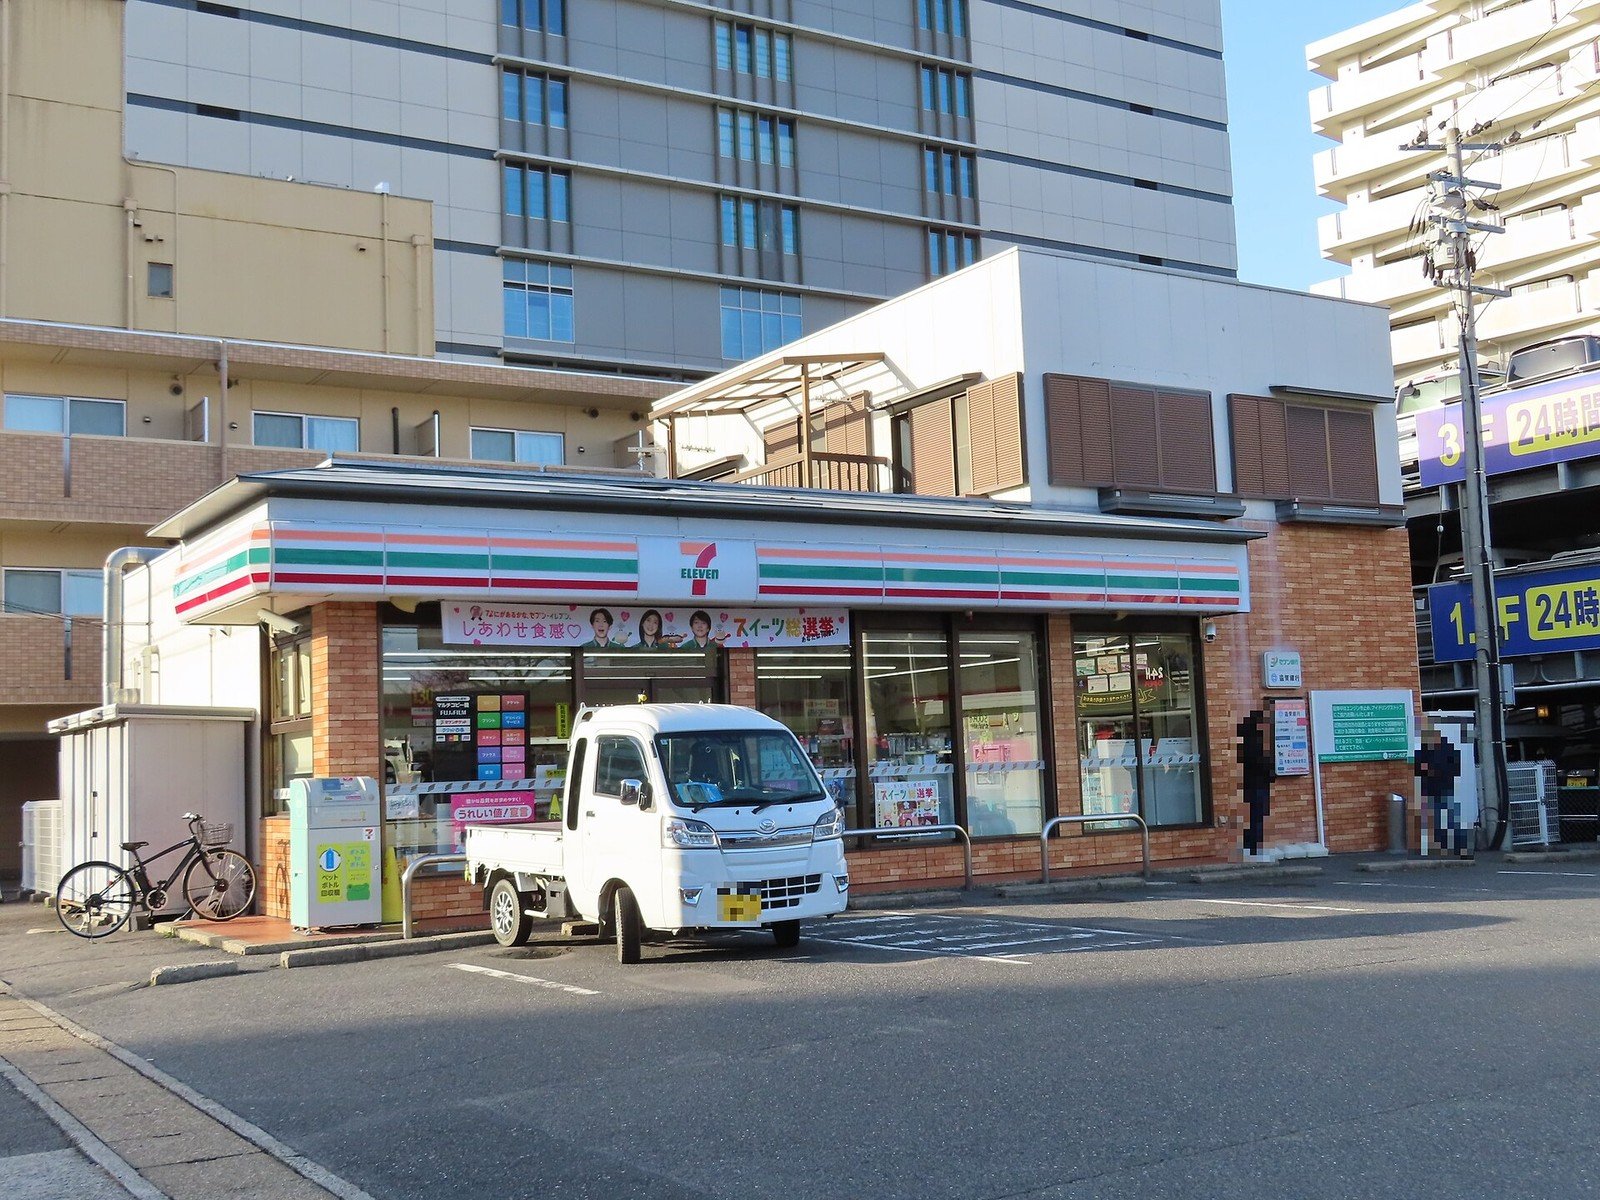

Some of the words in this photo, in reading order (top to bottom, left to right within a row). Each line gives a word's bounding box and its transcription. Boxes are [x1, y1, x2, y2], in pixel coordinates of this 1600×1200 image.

[1516, 394, 1600, 446] 24時間
[733, 616, 834, 638] スイーツ総選挙
[1535, 587, 1600, 632] 24時
